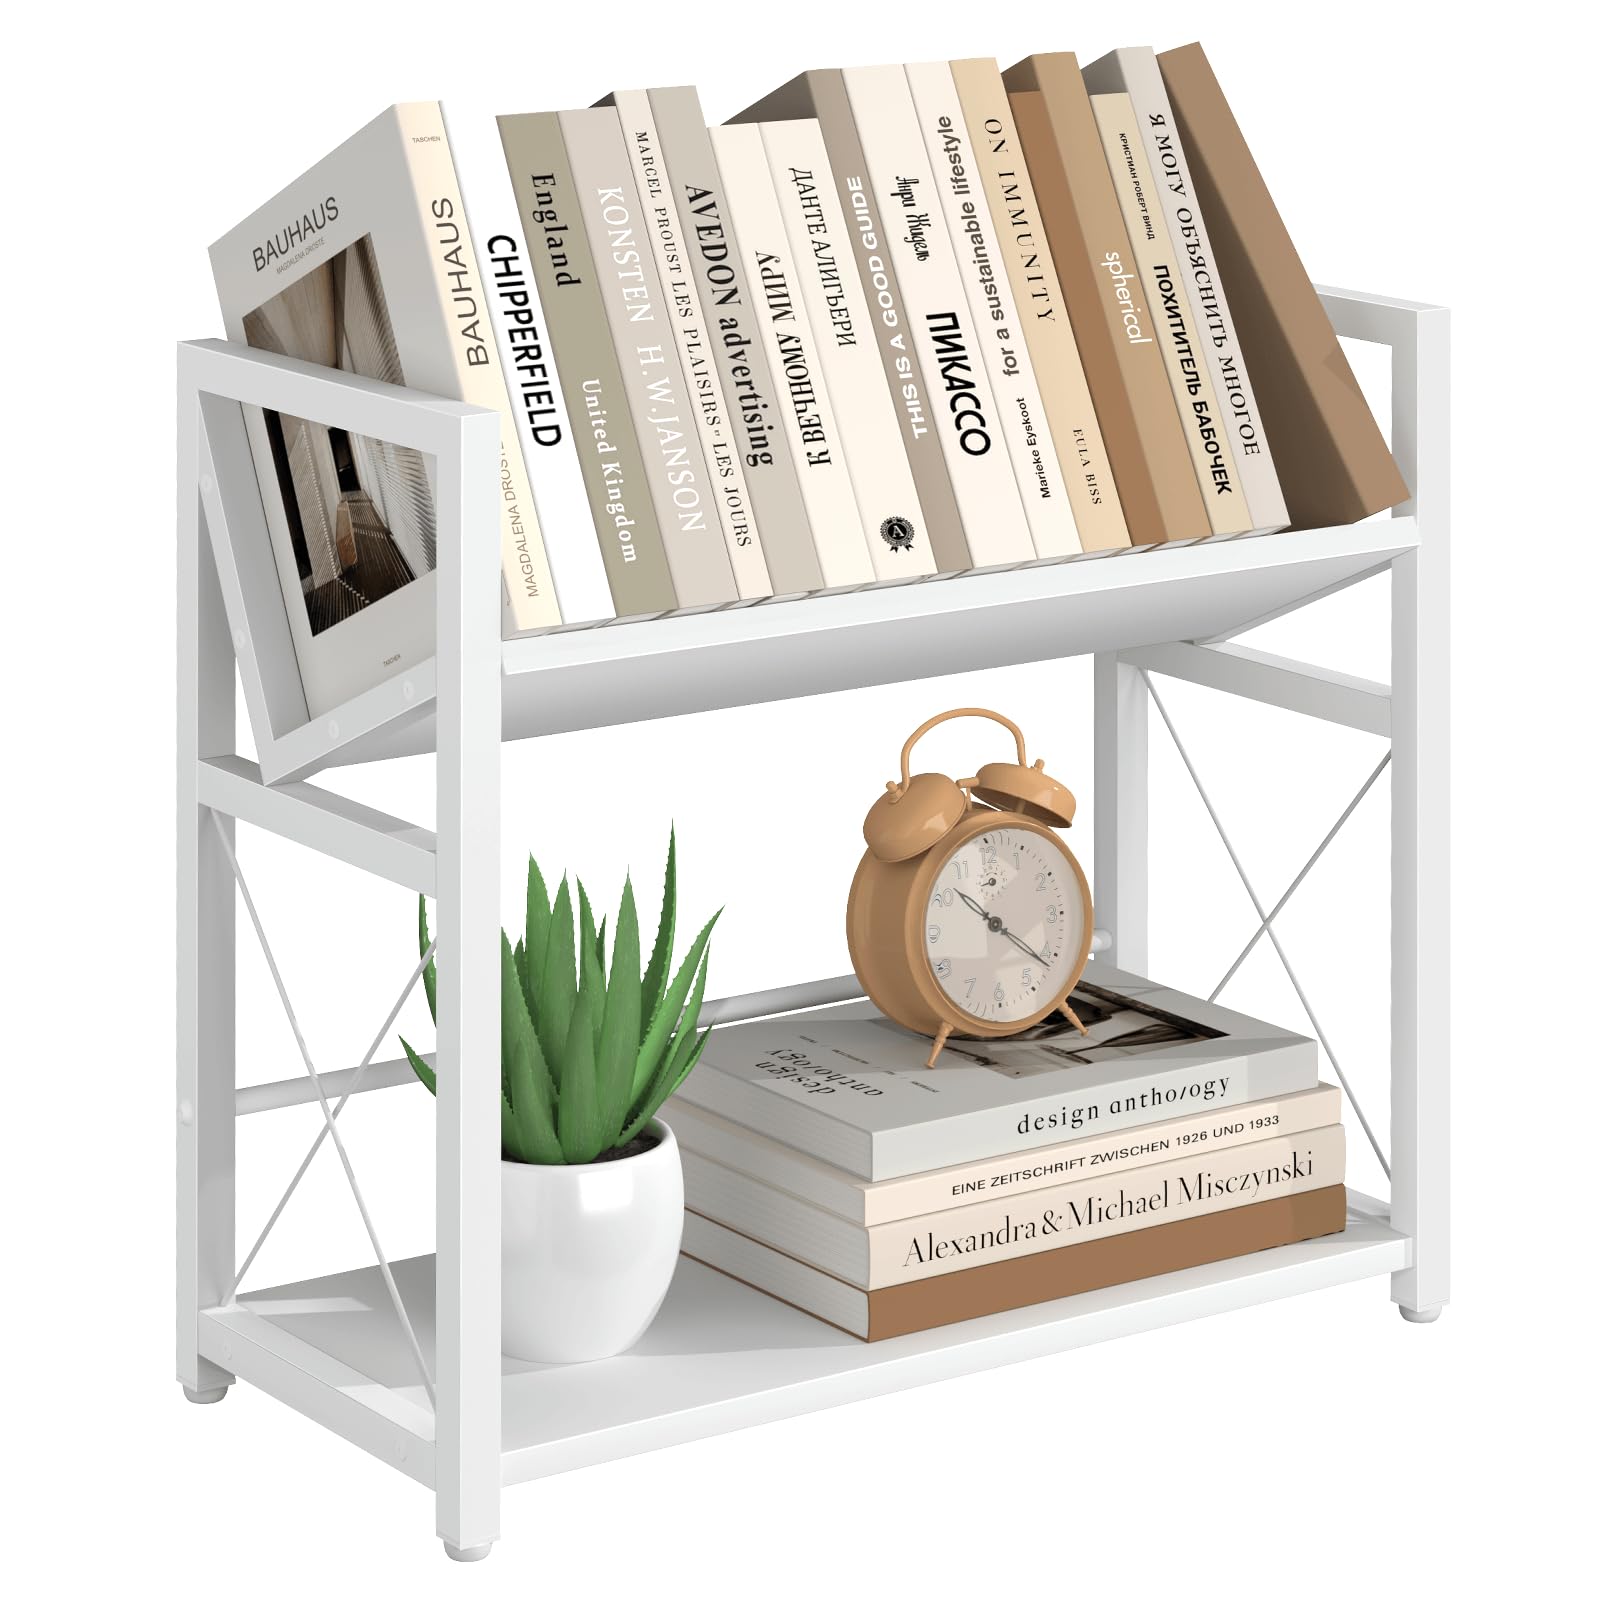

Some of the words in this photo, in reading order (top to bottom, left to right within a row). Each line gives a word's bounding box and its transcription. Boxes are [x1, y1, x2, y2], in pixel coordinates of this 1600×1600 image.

[937, 115, 970, 196] lifestyle
[1149, 113, 1166, 127] Я
[890, 175, 919, 208] Анри
[1119, 132, 1138, 179] КРИСТИАН
[1133, 180, 1148, 215] РОБЕРТ
[1143, 216, 1155, 240] ВИНД
[1155, 135, 1187, 198] МОГУ
[252, 197, 339, 272] BAUHAUS
[531, 173, 581, 287] England
[847, 175, 878, 250] GUIDE
[904, 213, 931, 262] Жидель
[984, 118, 1009, 153] ON
[998, 171, 1055, 322] IMMUNITY
[432, 198, 489, 366] BAUHAUS
[598, 186, 654, 322] KONSTEN
[755, 250, 796, 323] МИРУ
[788, 167, 829, 235] ДАНТЕ
[812, 238, 856, 347] АЛИГЬЕРИ
[869, 255, 898, 327] GOOD
[960, 201, 1005, 321] sustainable
[1176, 207, 1227, 348] ОБЪЯСНИТЬ
[685, 184, 742, 305] AVEDON
[719, 316, 774, 467] advertising
[997, 327, 1010, 340] a
[1101, 251, 1152, 344] spherical
[487, 234, 563, 447] CHIPPERFIELD
[635, 131, 662, 198] MARCEL
[655, 207, 681, 273] PROUST
[672, 281, 693, 318] LES
[683, 328, 721, 427] PLAISIRS
[713, 442, 734, 478] LES
[724, 486, 752, 547] JOURS
[890, 333, 906, 350] A
[896, 358, 913, 379] IS
[1000, 347, 1020, 377] for
[776, 332, 827, 446] ВЕЧНОМУ
[903, 383, 928, 439] THIS
[926, 311, 991, 456] ПИКАССО
[1153, 264, 1202, 396] ПОХИТИТЕЛЬ
[1192, 401, 1232, 495] БАБОЧЕК
[1218, 356, 1260, 456] МНОГОЕ
[807, 449, 831, 468] К
[1016, 397, 1037, 446] Eyskoot
[582, 378, 617, 454] United
[601, 462, 637, 563] Kingdom
[1032, 450, 1051, 499] Marieke
[1073, 428, 1091, 467] EULA
[1085, 474, 1102, 505] BISS
[509, 505, 539, 597] MAGDALENA
[980, 846, 997, 864] 12
[1035, 873, 1046, 891] 2
[1046, 905, 1057, 924] 3
[965, 977, 977, 998] 7
[994, 982, 1004, 1001] 6
[1022, 968, 1031, 987] 5
[755, 1061, 836, 1096] design
[952, 1180, 986, 1196] EINE
[990, 1156, 1087, 1187] ZEITSCHRIFT
[1090, 1138, 1170, 1165] ZWISCHEN
[1175, 1130, 1208, 1146] 1926
[1212, 1122, 1245, 1139] UND
[1249, 1115, 1280, 1131] 1933
[1017, 1104, 1099, 1136] design
[903, 1215, 1036, 1267] Alexandra
[1042, 1209, 1062, 1234] &
[1066, 1179, 1169, 1231] Michael
[1177, 1150, 1314, 1206] Misczynski
